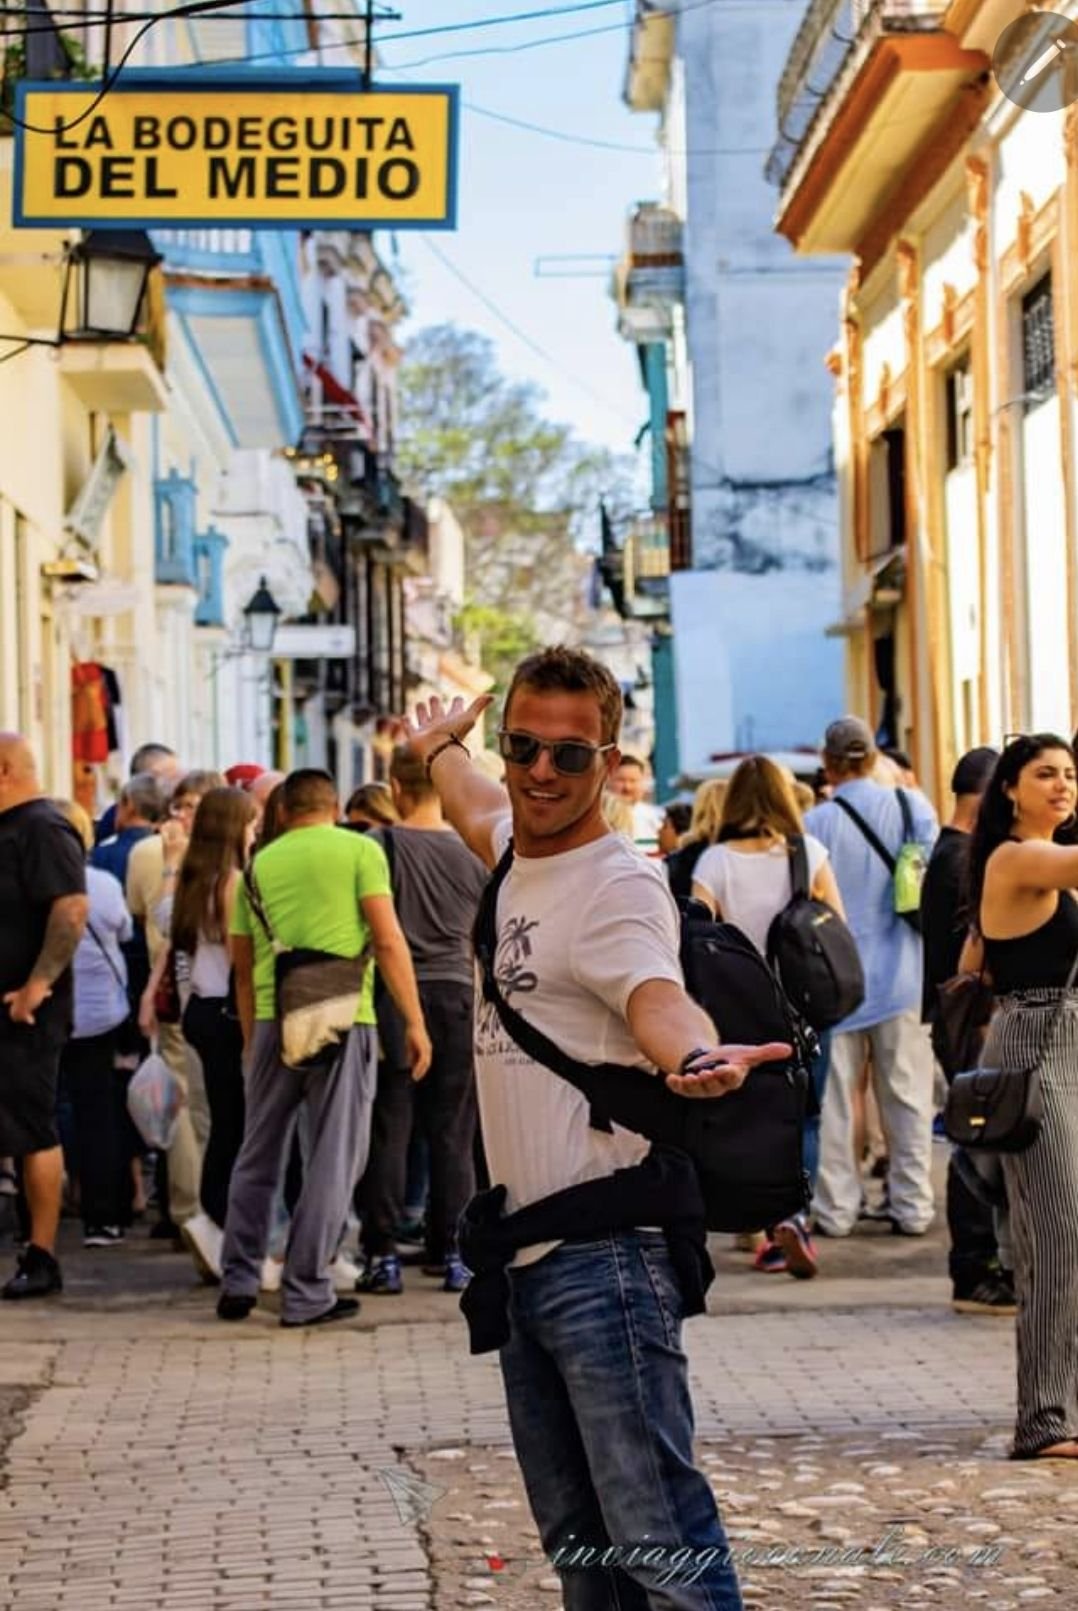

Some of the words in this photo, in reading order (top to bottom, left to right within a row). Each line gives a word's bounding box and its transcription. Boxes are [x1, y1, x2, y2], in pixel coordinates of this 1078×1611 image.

[55, 115, 114, 150] LA
[133, 115, 415, 151] BODEGUITA
[53, 156, 178, 199] DEL
[208, 156, 420, 200] MEDIO
